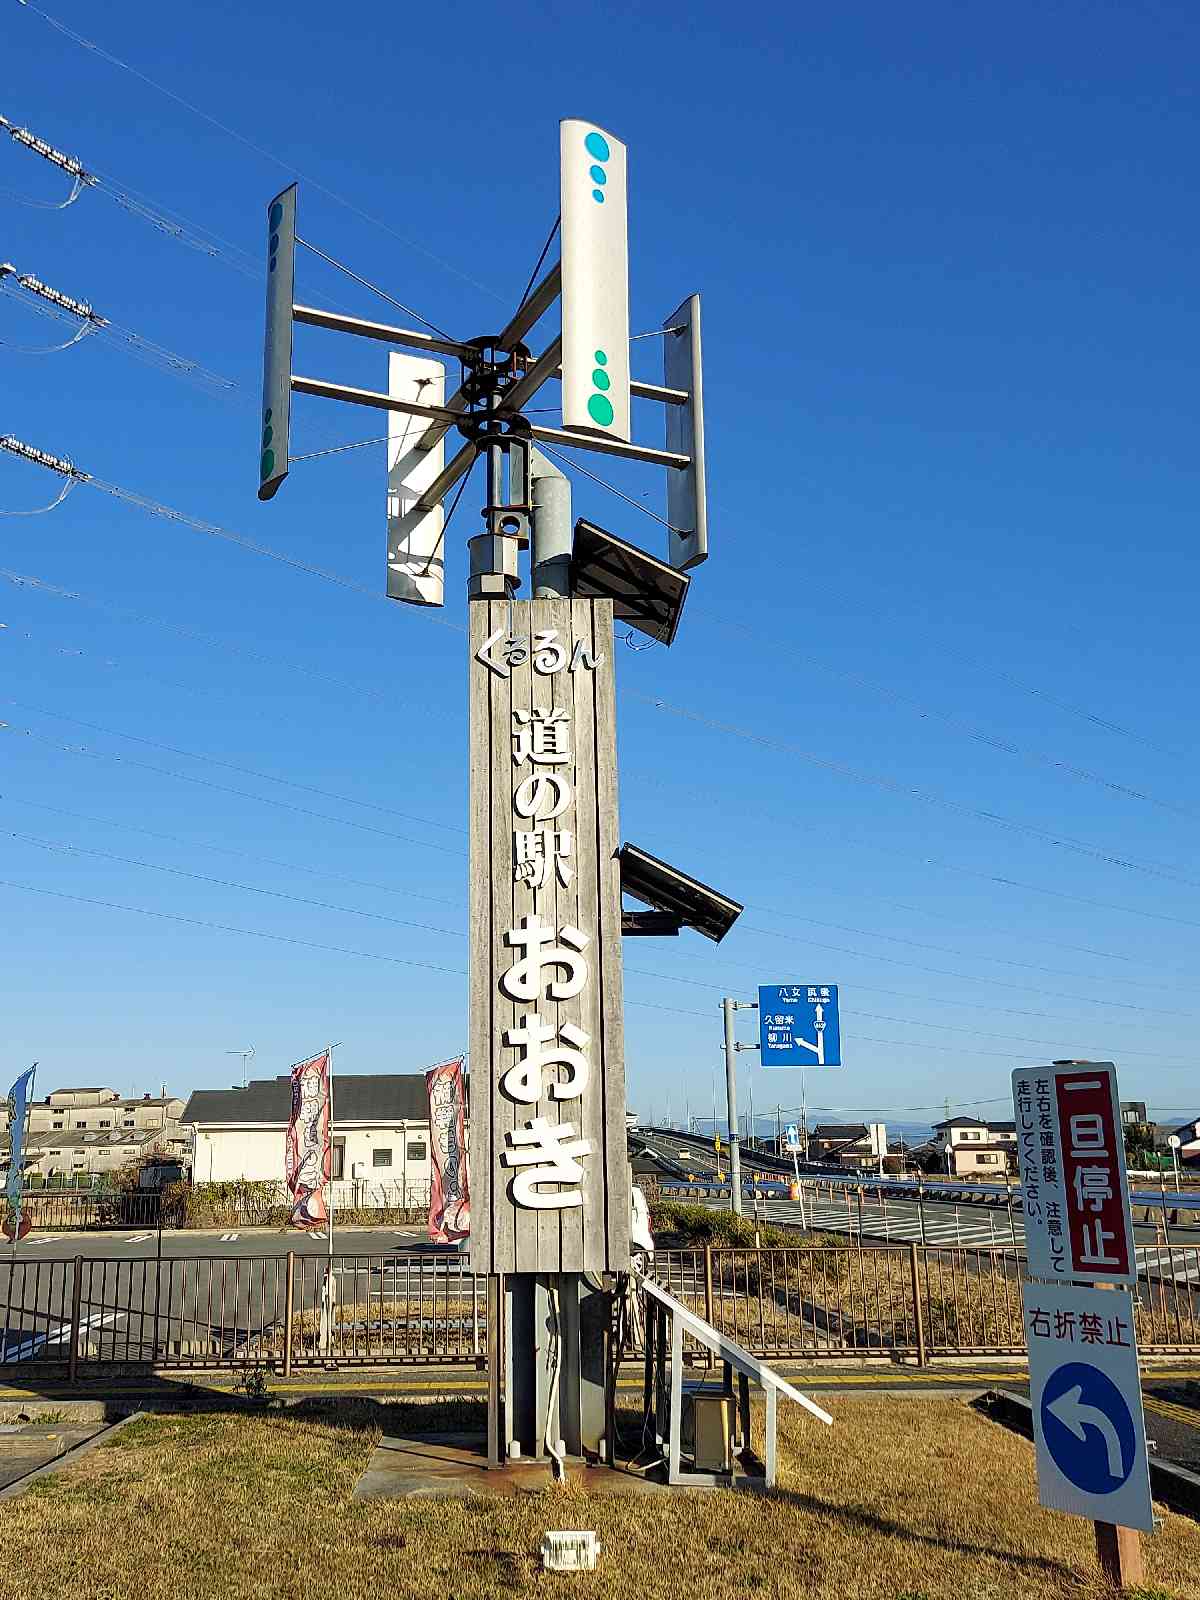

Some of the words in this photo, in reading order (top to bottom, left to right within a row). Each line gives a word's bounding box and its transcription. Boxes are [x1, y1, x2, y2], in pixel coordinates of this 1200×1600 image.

[475, 629, 605, 678] くるるん
[513, 707, 575, 889] 道の駅
[499, 914, 592, 1210] おおき
[764, 1015, 795, 1025] 久留米
[1017, 1080, 1043, 1225] 走行してください。
[1064, 1080, 1121, 1265] 一旦停止
[1029, 1307, 1131, 1347] 右折禁止
